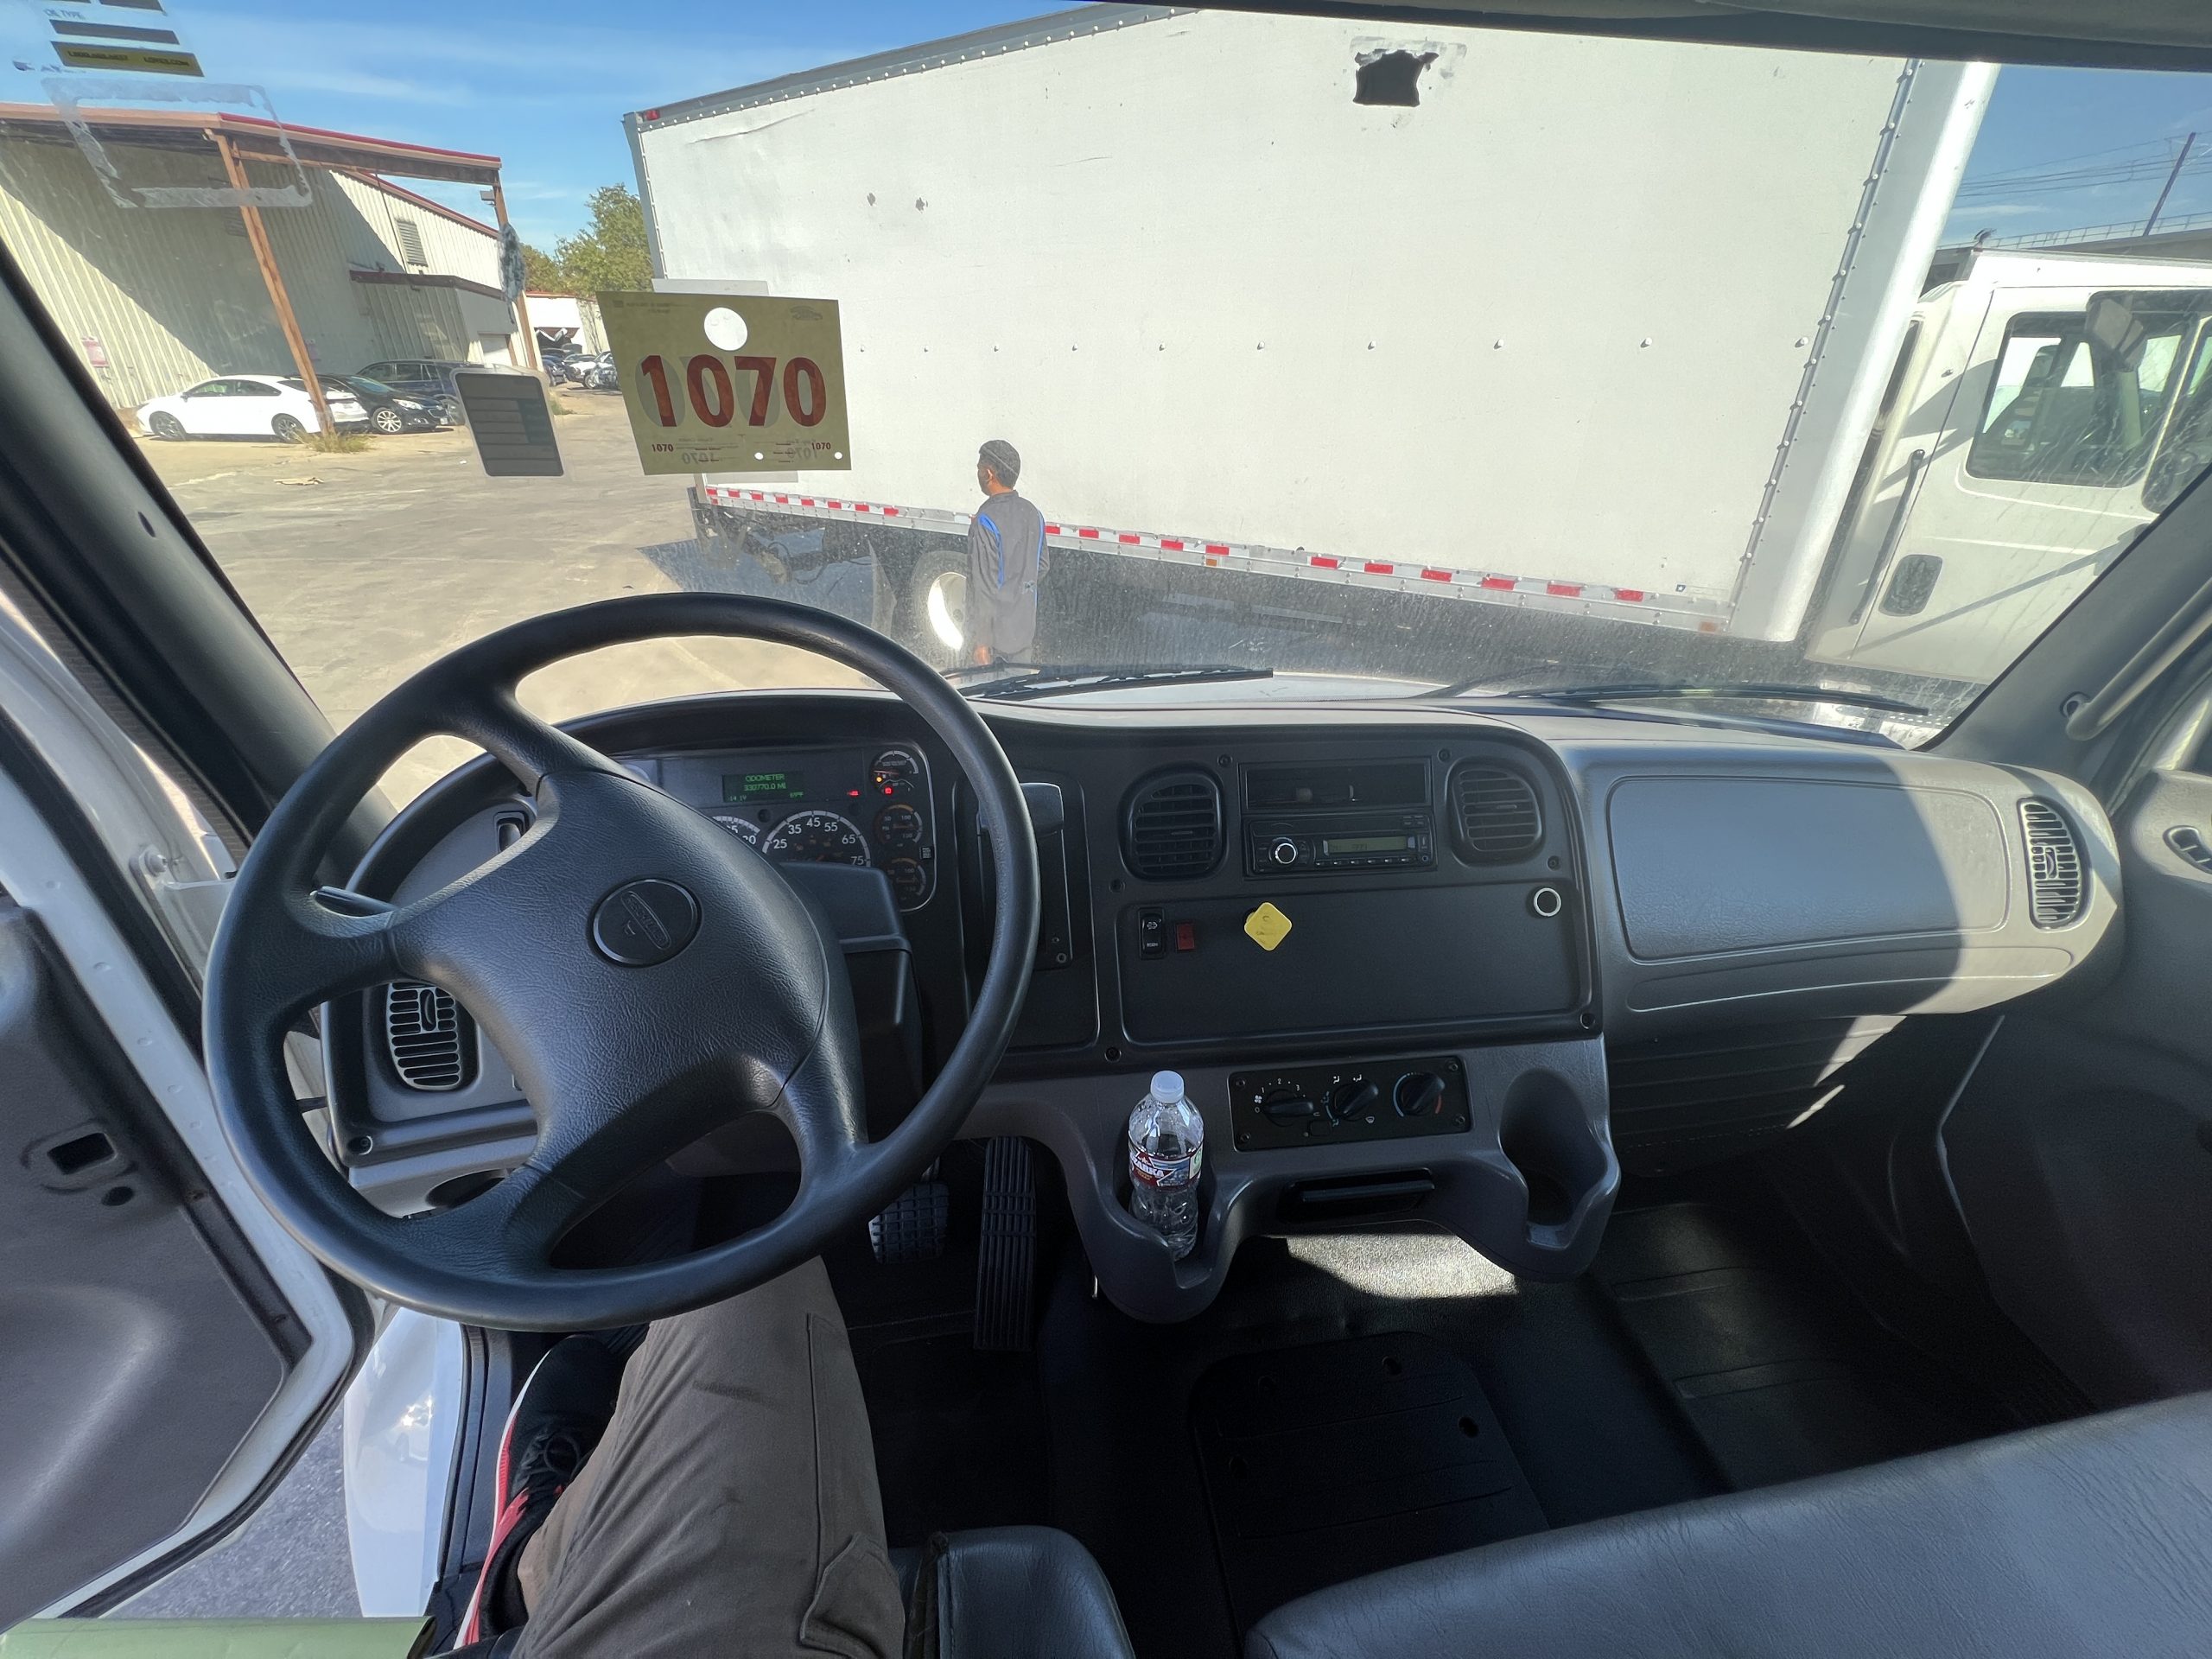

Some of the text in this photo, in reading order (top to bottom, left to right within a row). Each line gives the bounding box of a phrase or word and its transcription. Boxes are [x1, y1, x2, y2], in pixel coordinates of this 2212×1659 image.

[641, 354, 827, 428] 1070
[652, 443, 674, 453] 1070
[810, 442, 831, 451] 1070
[745, 773, 785, 782] ODOMETER
[805, 817, 821, 827] 45
[823, 822, 838, 832] 55
[788, 824, 802, 835] 35
[773, 839, 787, 849] 25
[842, 835, 856, 844] 65
[851, 855, 864, 865] 75
